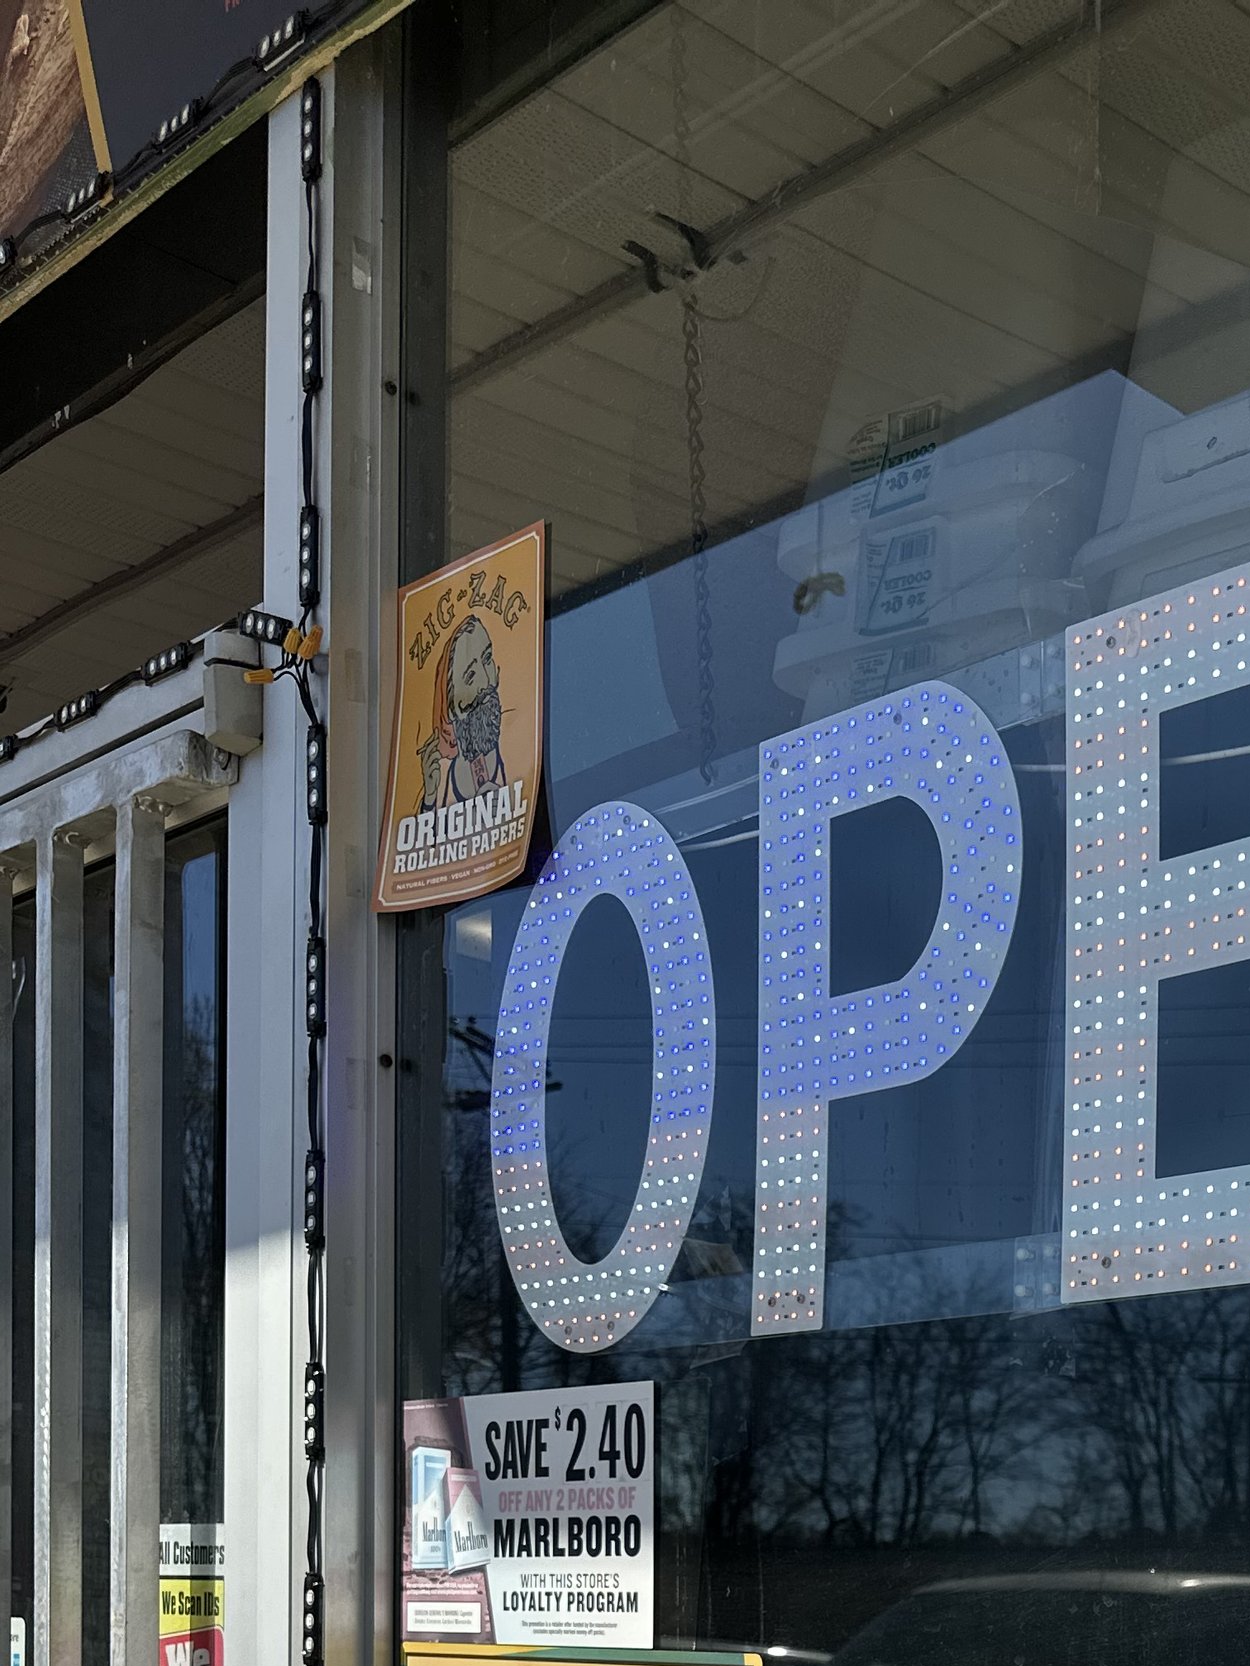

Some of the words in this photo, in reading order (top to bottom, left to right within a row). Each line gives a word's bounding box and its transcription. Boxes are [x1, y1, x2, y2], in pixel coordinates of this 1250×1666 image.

[409, 570, 528, 670] ZIG-ZAG
[396, 780, 528, 852] ORIGINAL
[393, 839, 468, 874] ROLLING
[471, 816, 526, 857] PAPERS
[485, 1418, 550, 1481] SAVE
[499, 1491, 523, 1513] OFF
[525, 1489, 553, 1512] ANY
[556, 1488, 565, 1512] 2
[568, 1486, 615, 1511] PACKS
[617, 1486, 637, 1509] OF
[173, 1540, 225, 1565] Customers
[494, 1514, 642, 1558] MARLBORO
[520, 1573, 546, 1589] WITH
[549, 1573, 573, 1589] THIS
[576, 1573, 620, 1589] STORE'S
[162, 1590, 177, 1615] We
[178, 1590, 202, 1616] Scan
[203, 1591, 220, 1616] IDs
[503, 1591, 563, 1612] LOYALTY
[567, 1591, 639, 1613] PROGRAM
